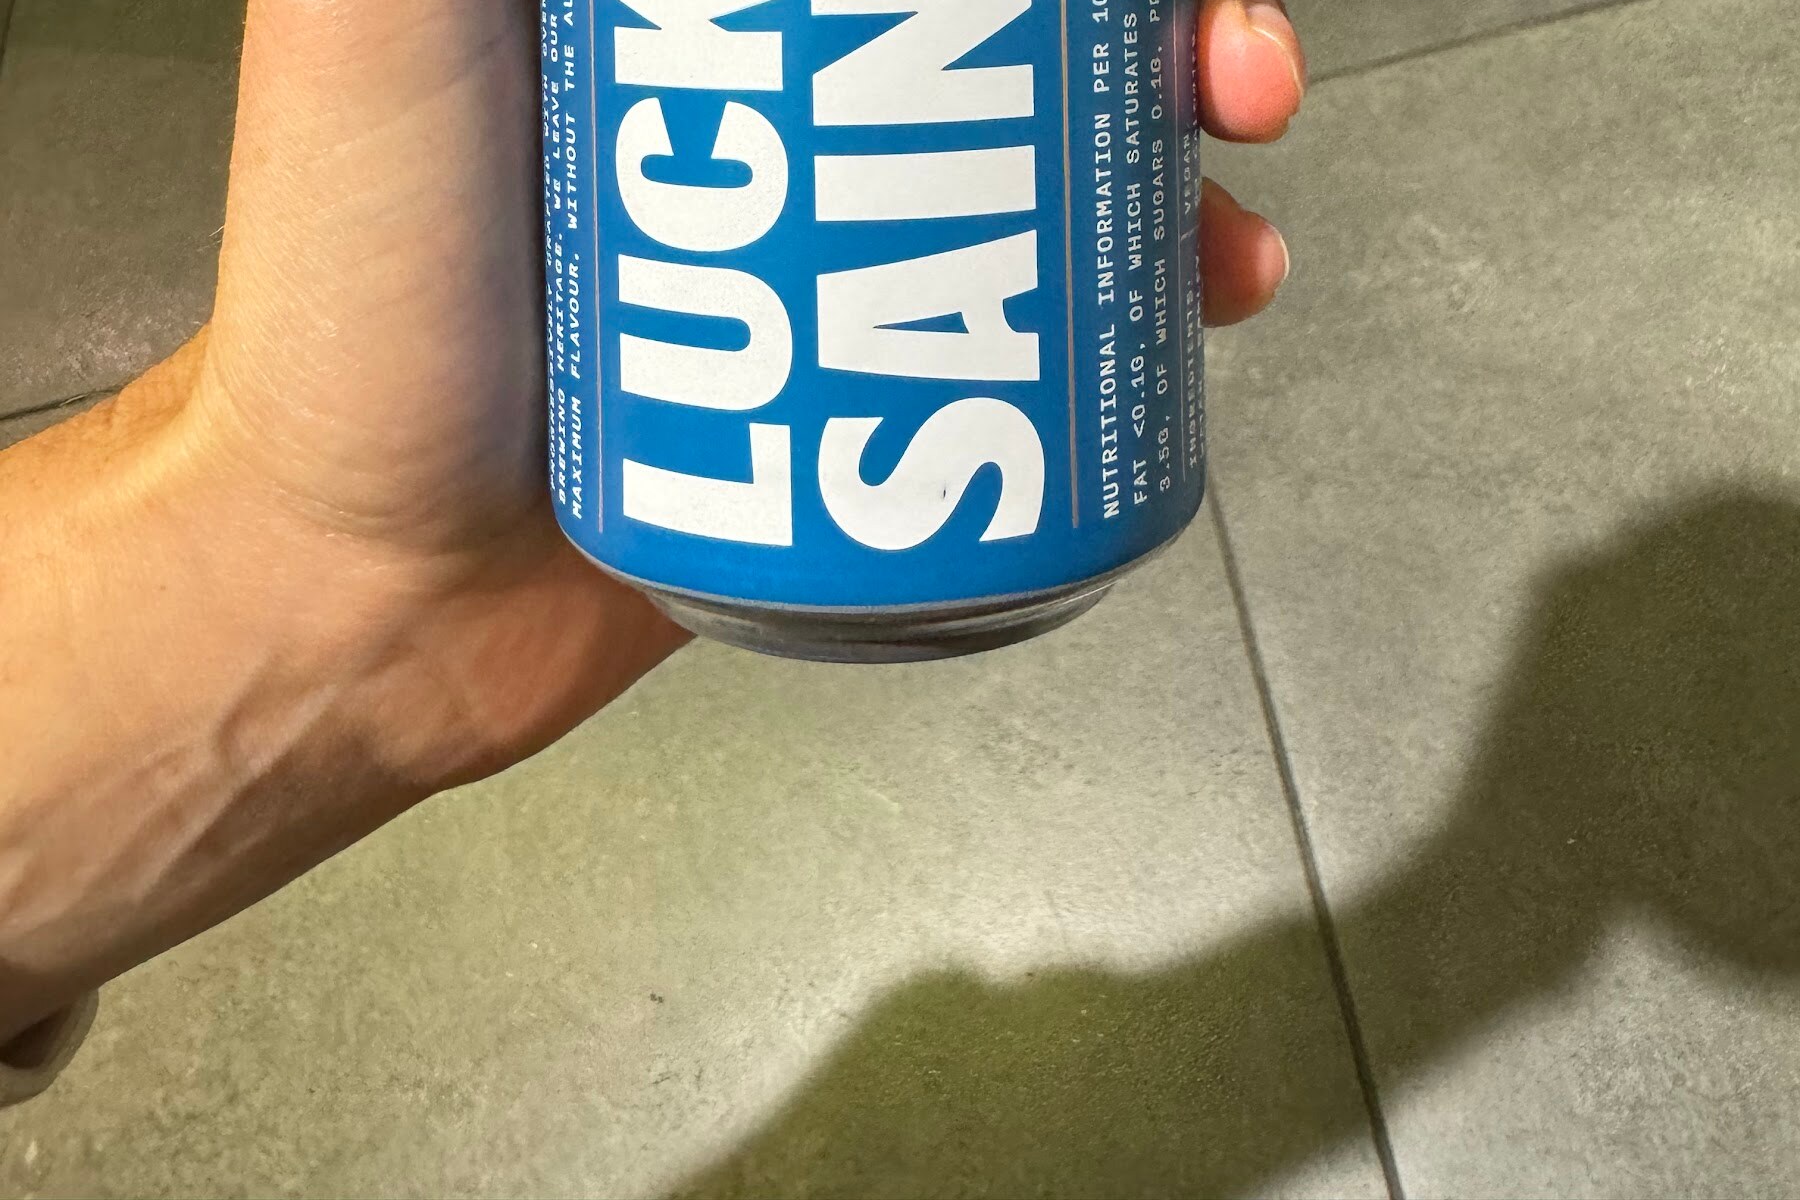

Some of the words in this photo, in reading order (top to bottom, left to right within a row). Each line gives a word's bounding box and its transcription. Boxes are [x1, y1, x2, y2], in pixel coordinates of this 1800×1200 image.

[550, 13, 559, 63] OUR
[564, 44, 576, 92] THE
[1093, 42, 1110, 93] PER
[550, 79, 561, 160] LEAVE
[1123, 11, 1140, 164] SATURATES
[553, 178, 562, 211] WE
[565, 112, 578, 230] WITHOUT
[1094, 113, 1115, 306] INFORMATION
[1151, 138, 1165, 241] SUGARS
[1127, 183, 1142, 271] WHICH
[568, 252, 582, 380] FLAVOUR.
[1129, 289, 1143, 322] OF
[1154, 258, 1167, 345] WHICH
[1099, 323, 1119, 519] NUTRITIONAL
[1130, 343, 1146, 439] <0.1G,
[1156, 363, 1168, 395] OF
[557, 387, 567, 505] BREWING
[571, 395, 583, 520] MAXIMUM
[1133, 459, 1148, 505] FAT
